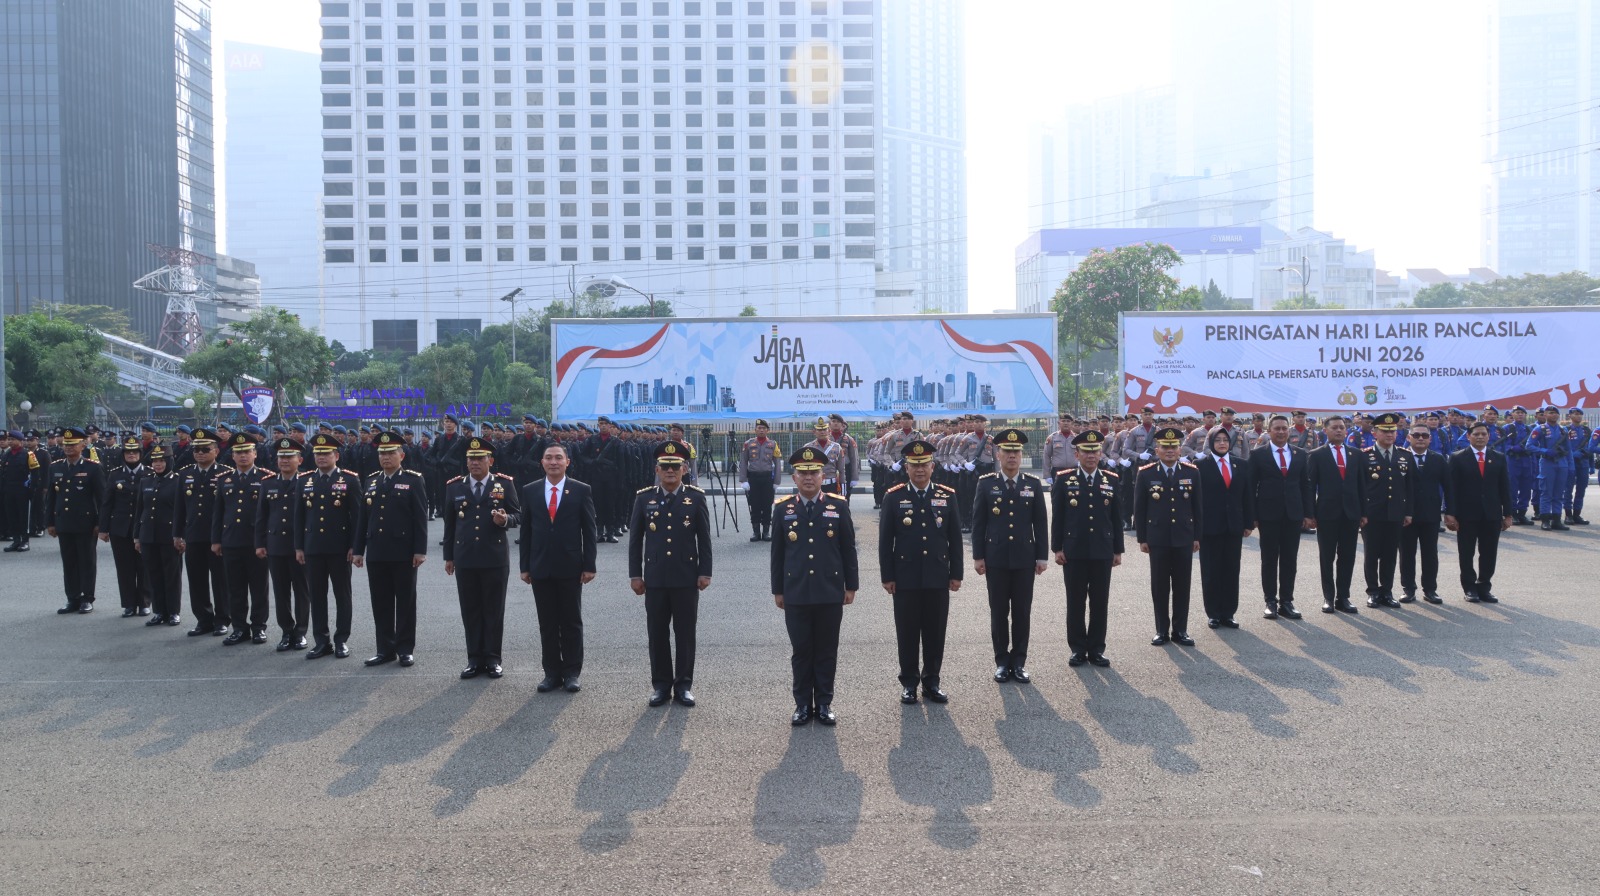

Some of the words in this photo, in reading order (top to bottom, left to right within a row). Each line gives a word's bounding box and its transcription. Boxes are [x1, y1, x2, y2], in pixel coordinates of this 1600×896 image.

[230, 53, 262, 68] AIA
[1205, 324, 1319, 341] PERINGATAN
[1326, 323, 1369, 340] HARI
[1375, 322, 1428, 339] LAHIR
[1435, 321, 1537, 338] PANCASILA
[753, 334, 805, 363] JAGA
[1318, 347, 1324, 362] 1
[1330, 346, 1372, 363] JUNI
[1378, 345, 1424, 362] 2026
[1207, 369, 1265, 380] PANCASILA
[1268, 368, 1328, 379] PEMERSATU
[1331, 368, 1379, 380] BANGSA,
[1381, 367, 1428, 378] FONDASI
[1430, 366, 1500, 377] PERDAMAIAN
[1503, 366, 1537, 376] DUNIA
[340, 387, 425, 400] LAPANGAN
[284, 405, 395, 419] PRESISI
[399, 402, 512, 419] DITLANTAS
